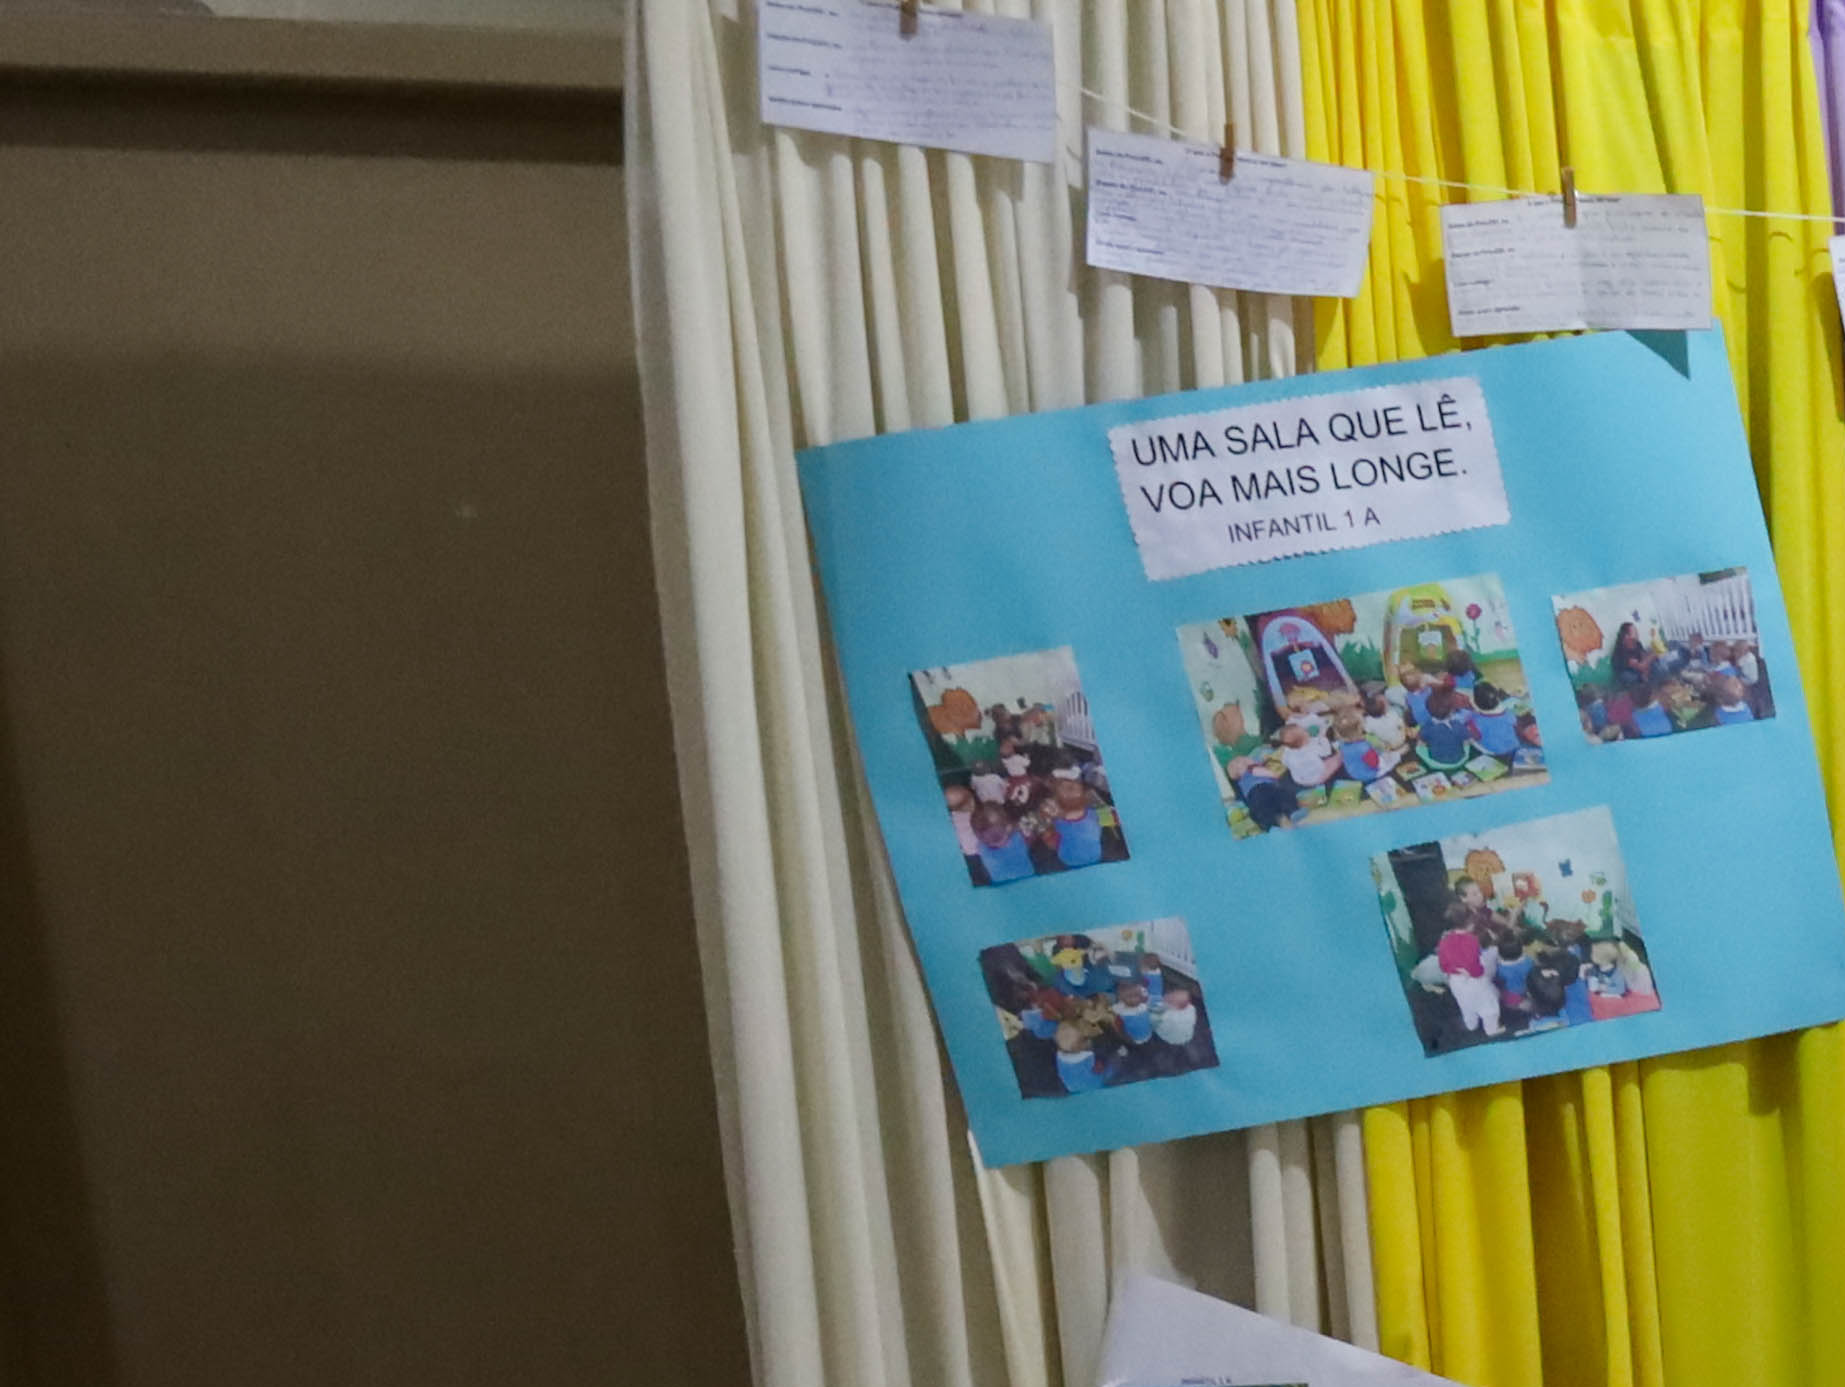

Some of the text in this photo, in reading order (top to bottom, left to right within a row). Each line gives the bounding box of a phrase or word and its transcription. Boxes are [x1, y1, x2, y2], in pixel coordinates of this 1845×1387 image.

[1131, 393, 1472, 467] UMA SALA QUE LÊ,
[1140, 447, 1467, 513] VOA MAIS LONGE.
[1227, 507, 1380, 543] INFANTIL 1 A
